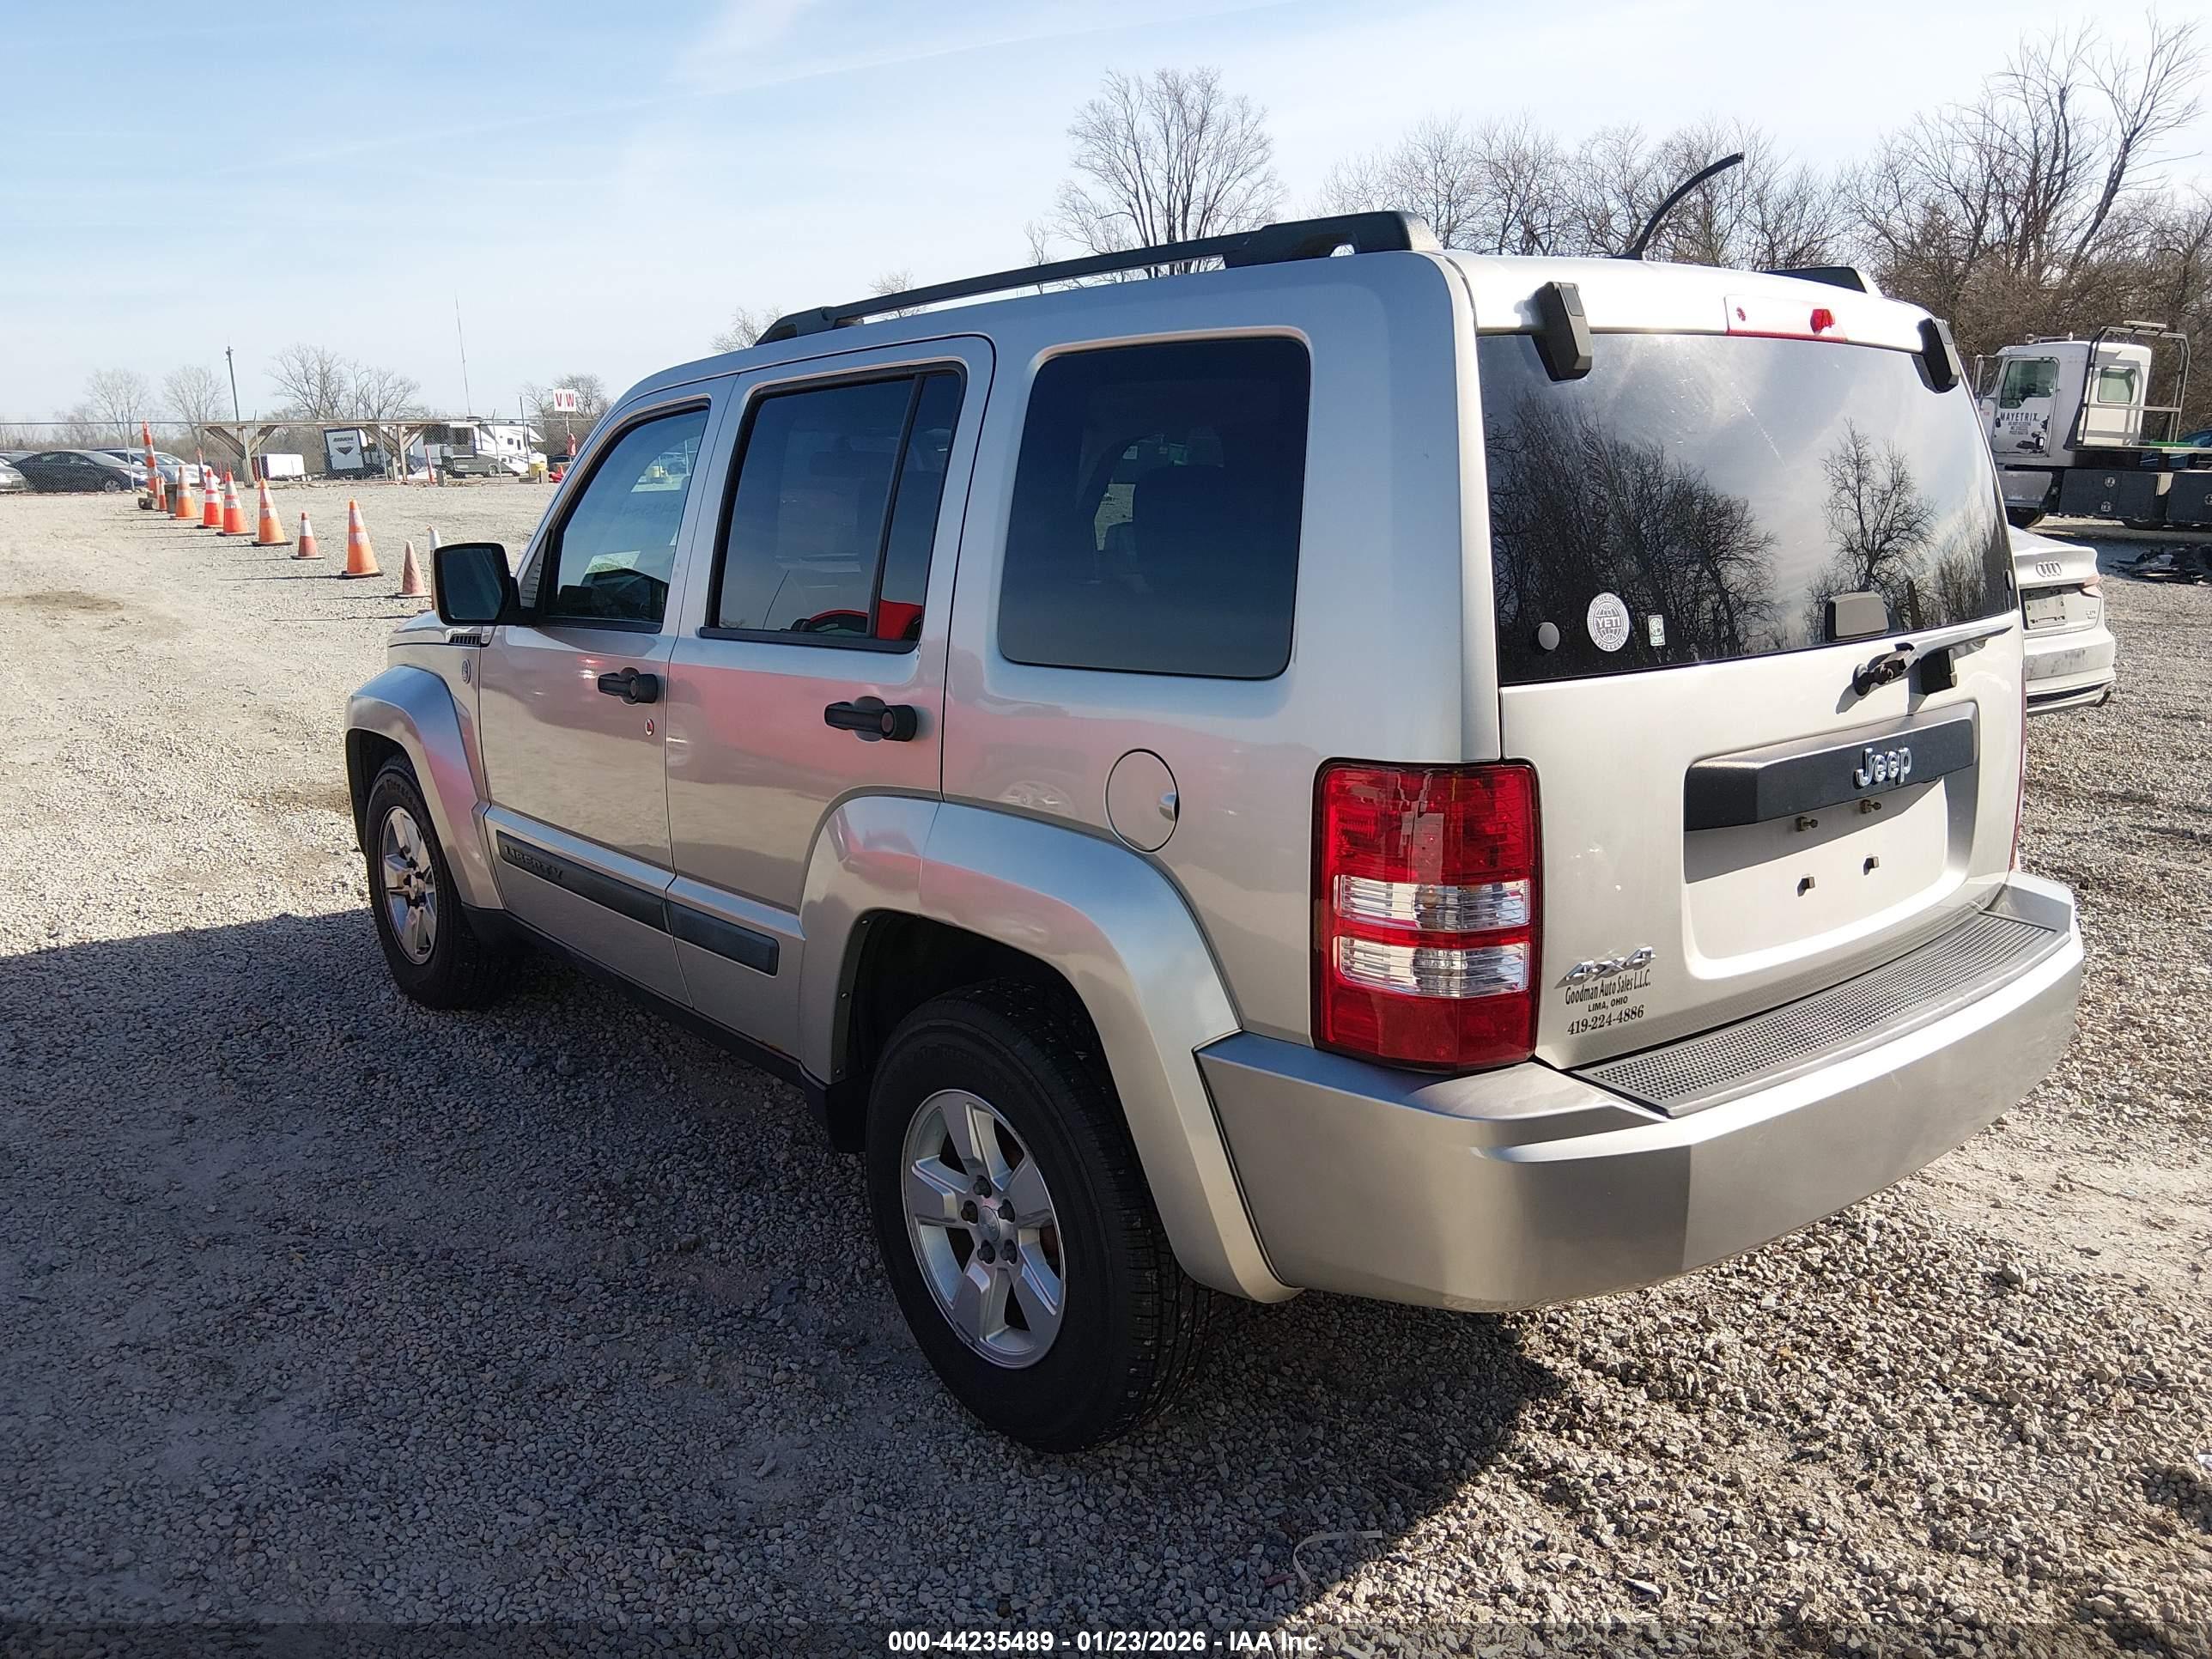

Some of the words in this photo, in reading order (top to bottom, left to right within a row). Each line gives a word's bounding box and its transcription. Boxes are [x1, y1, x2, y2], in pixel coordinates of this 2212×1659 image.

[2000, 412, 2038, 422] MAYETRIX
[1596, 617, 1621, 628] YETI
[1854, 746, 1912, 787] Jeep
[504, 844, 563, 880] LIBERTY
[1565, 985, 1598, 1006] Goodman
[1599, 980, 1616, 999] Auto
[1617, 975, 1632, 994] Sales
[1634, 969, 1651, 990] L.L.C.
[1588, 1001, 1608, 1012] LIMA,
[1610, 995, 1628, 1007] OHIO
[1567, 1004, 1644, 1036] 419-224-4886
